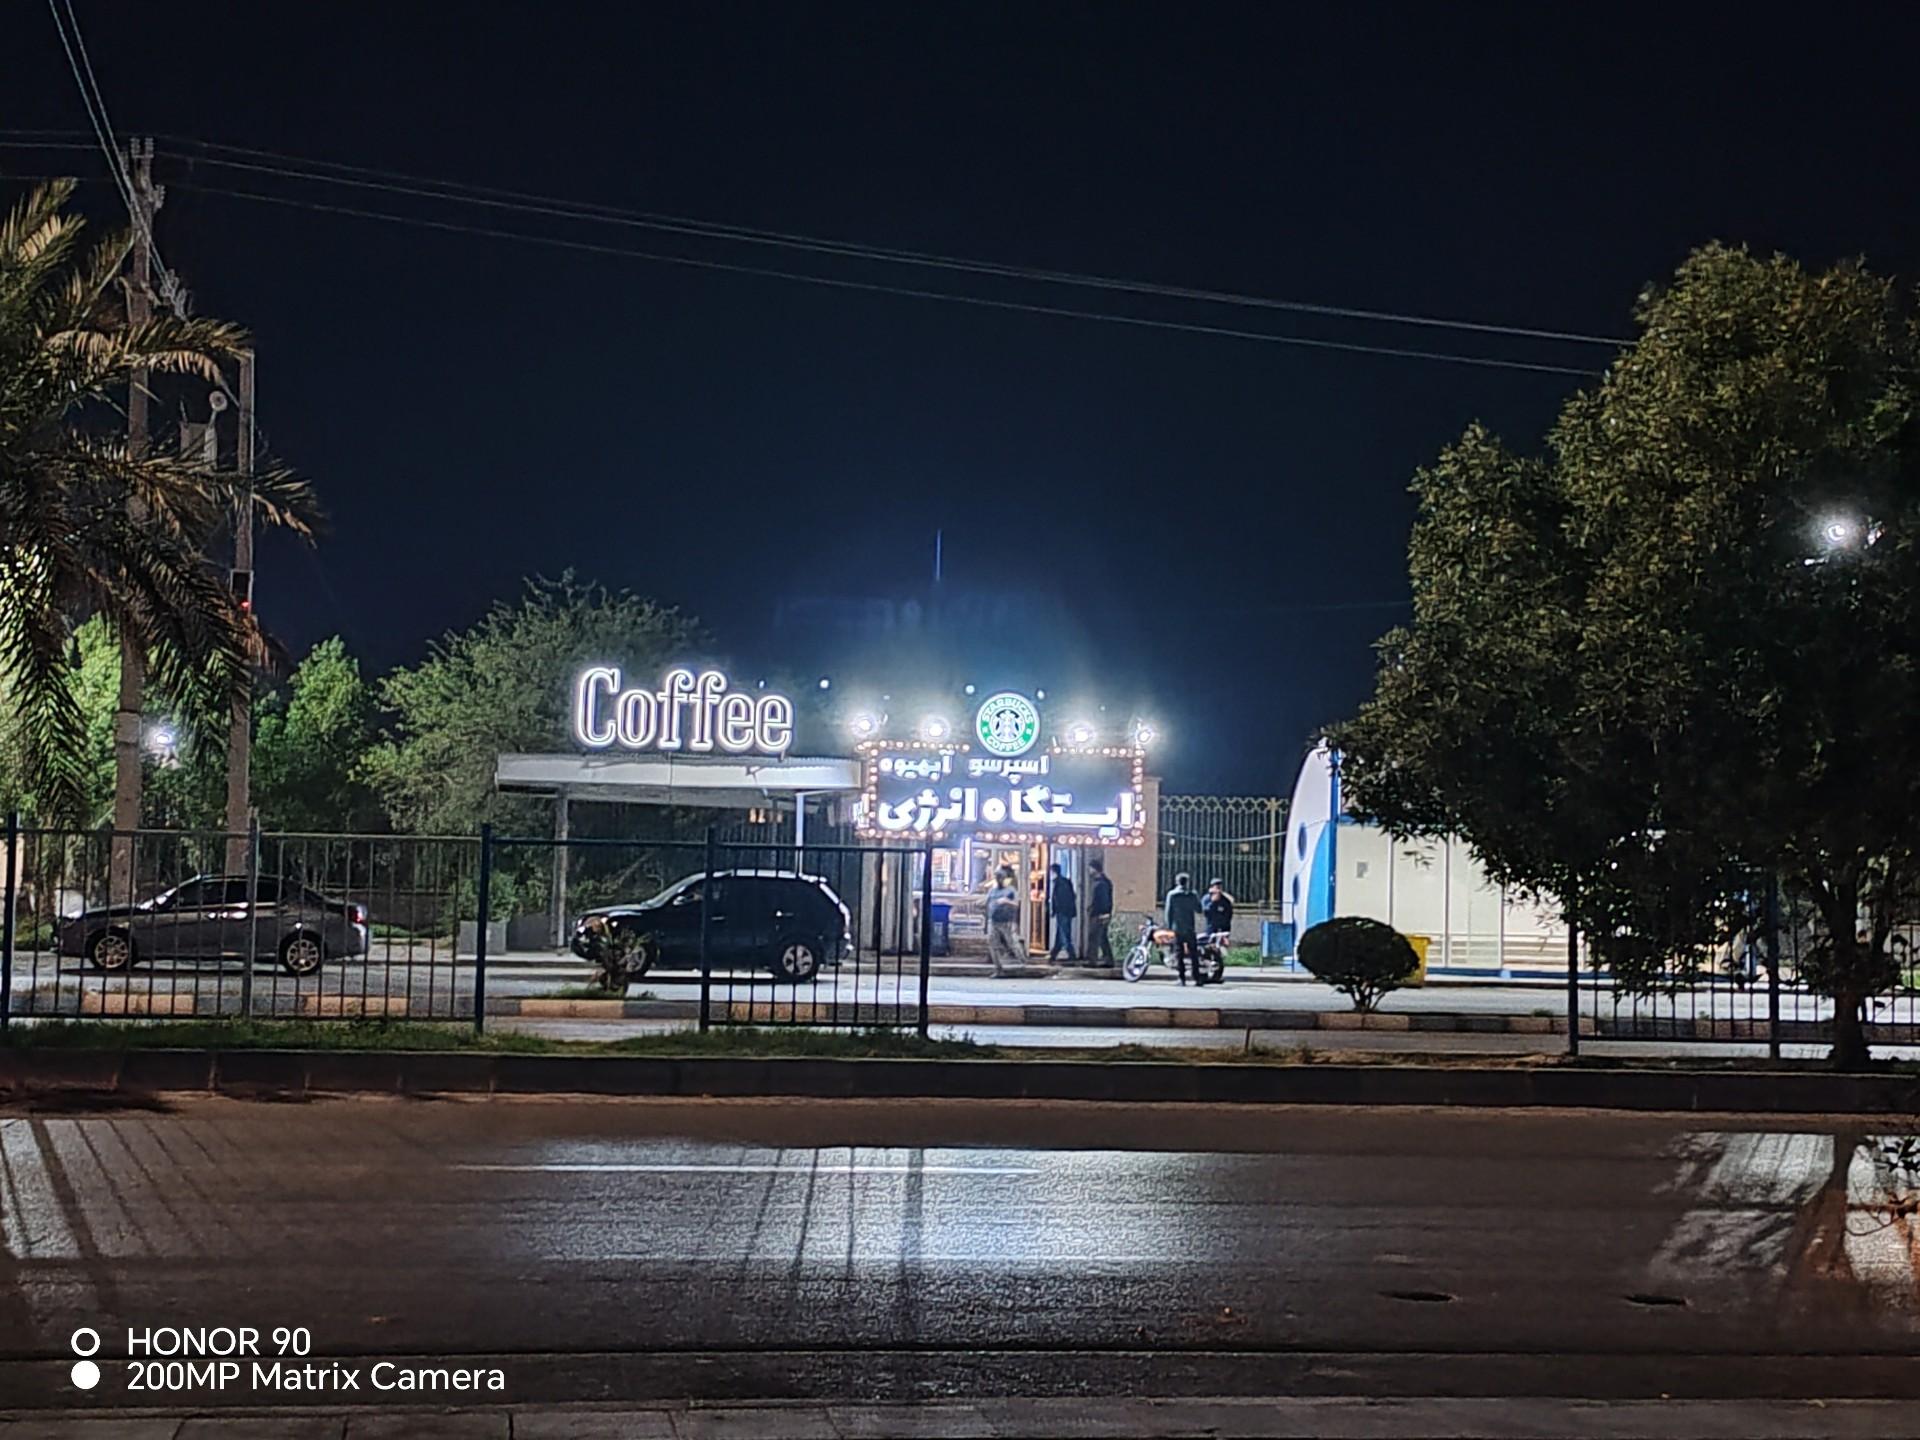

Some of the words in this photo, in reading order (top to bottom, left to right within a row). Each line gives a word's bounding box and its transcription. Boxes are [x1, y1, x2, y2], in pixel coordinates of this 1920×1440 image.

[577, 667, 794, 752] Coffee
[982, 697, 1034, 721] STARBUCKS
[986, 736, 1025, 752] COFFEE
[968, 755, 1049, 785] اسپرسو
[877, 786, 979, 832] انرژی
[982, 785, 1135, 840] ایستگاه
